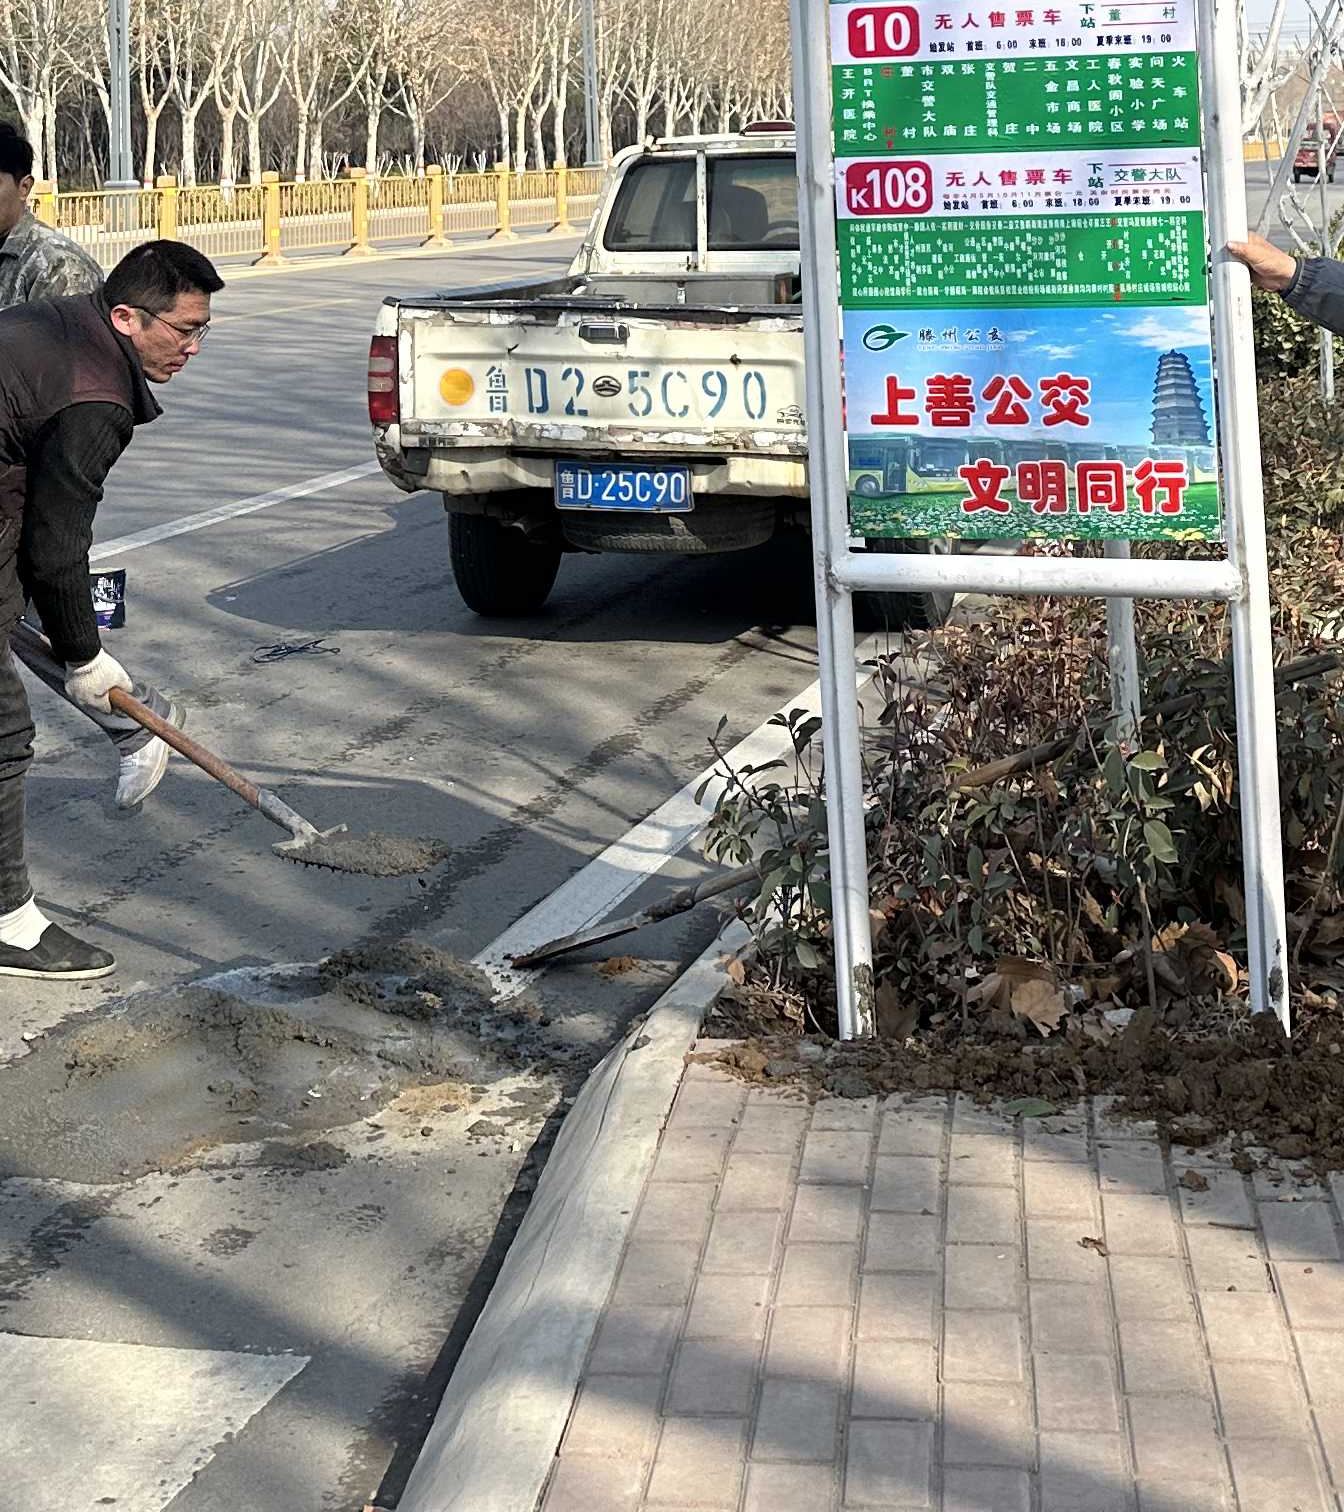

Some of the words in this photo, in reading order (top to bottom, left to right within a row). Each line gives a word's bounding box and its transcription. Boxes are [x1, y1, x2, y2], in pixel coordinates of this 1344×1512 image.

[856, 12, 911, 52] 10
[935, 9, 1062, 30] 无人售票车
[1079, 3, 1096, 29] 下站
[961, 63, 978, 137] 张庄
[1023, 63, 1040, 135] 二中
[1044, 60, 1061, 134] 五金市场
[1086, 59, 1104, 133] 工人医院
[1171, 55, 1189, 130] 火车站
[851, 167, 927, 209] K108
[946, 168, 1072, 187] 无人售票车
[1087, 162, 1104, 188] 下站
[1114, 167, 1182, 183] 交警大队
[869, 373, 1091, 428] 上善公交
[959, 458, 1189, 515] 文明同行
